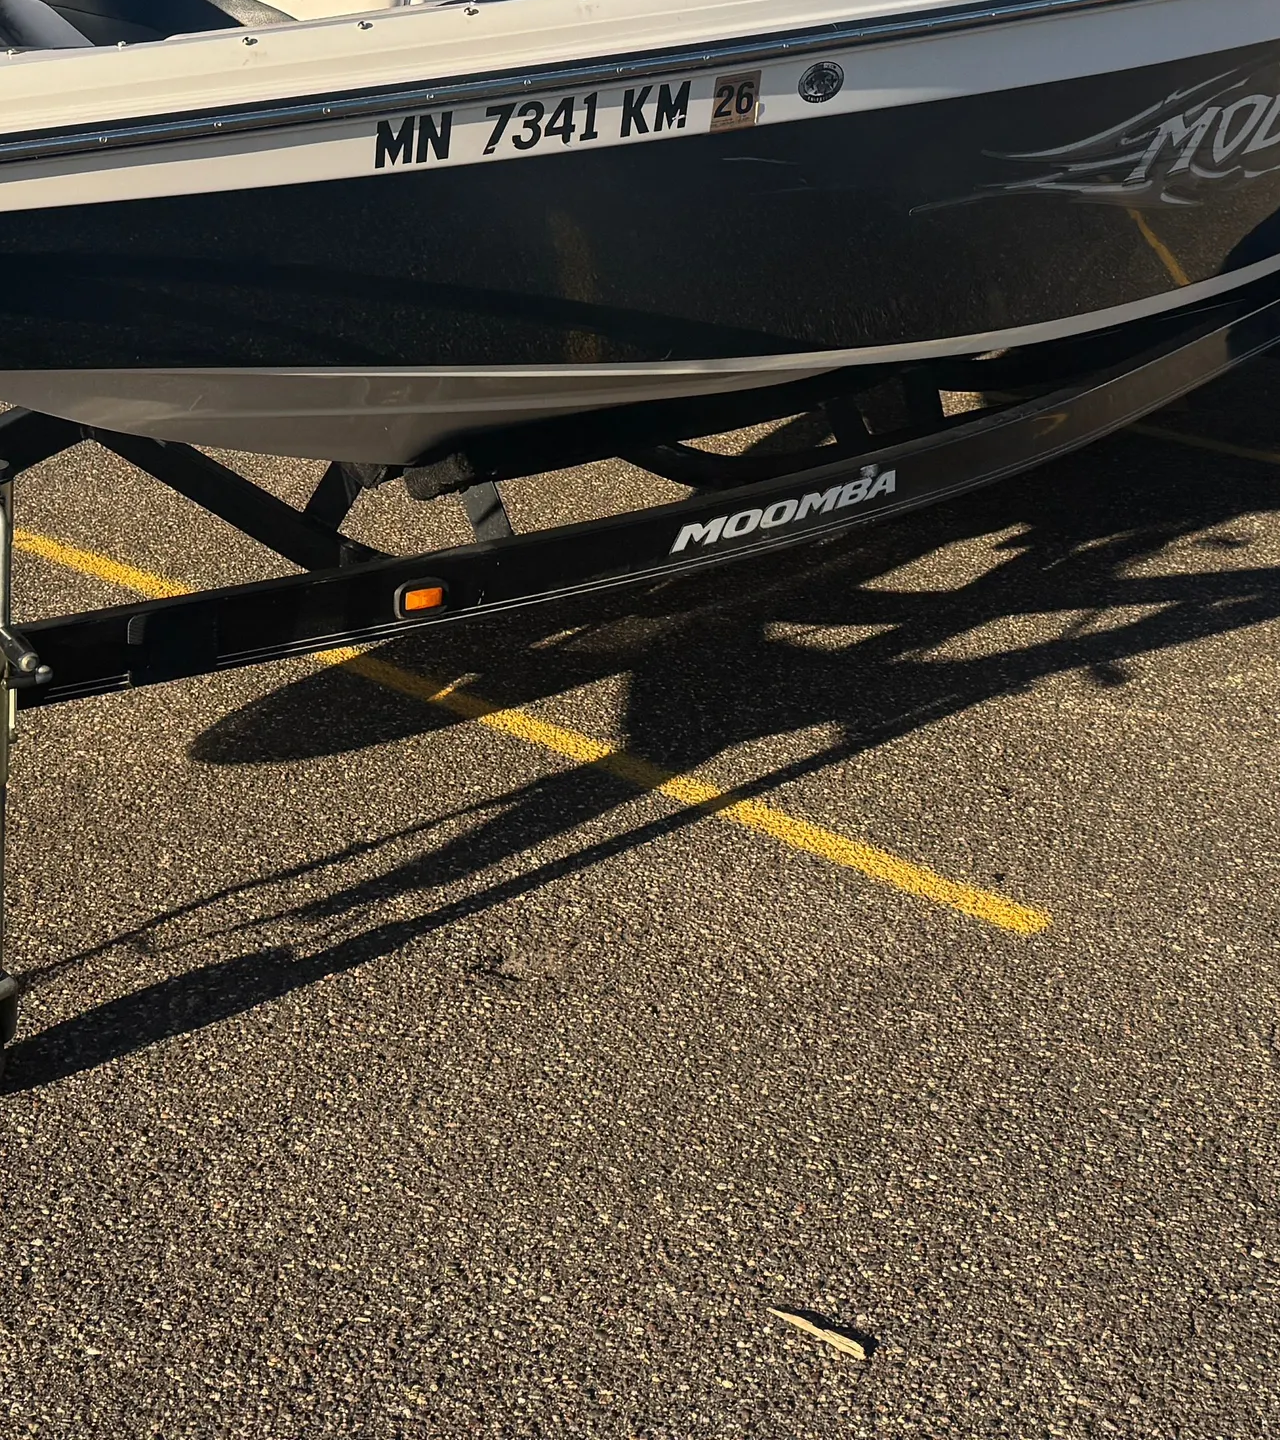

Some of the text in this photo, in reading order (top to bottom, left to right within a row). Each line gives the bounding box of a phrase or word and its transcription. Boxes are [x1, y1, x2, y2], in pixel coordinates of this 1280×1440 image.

[375, 81, 691, 169] MN 7341 KM
[714, 81, 755, 118] 26
[669, 469, 896, 555] MOOMBA
